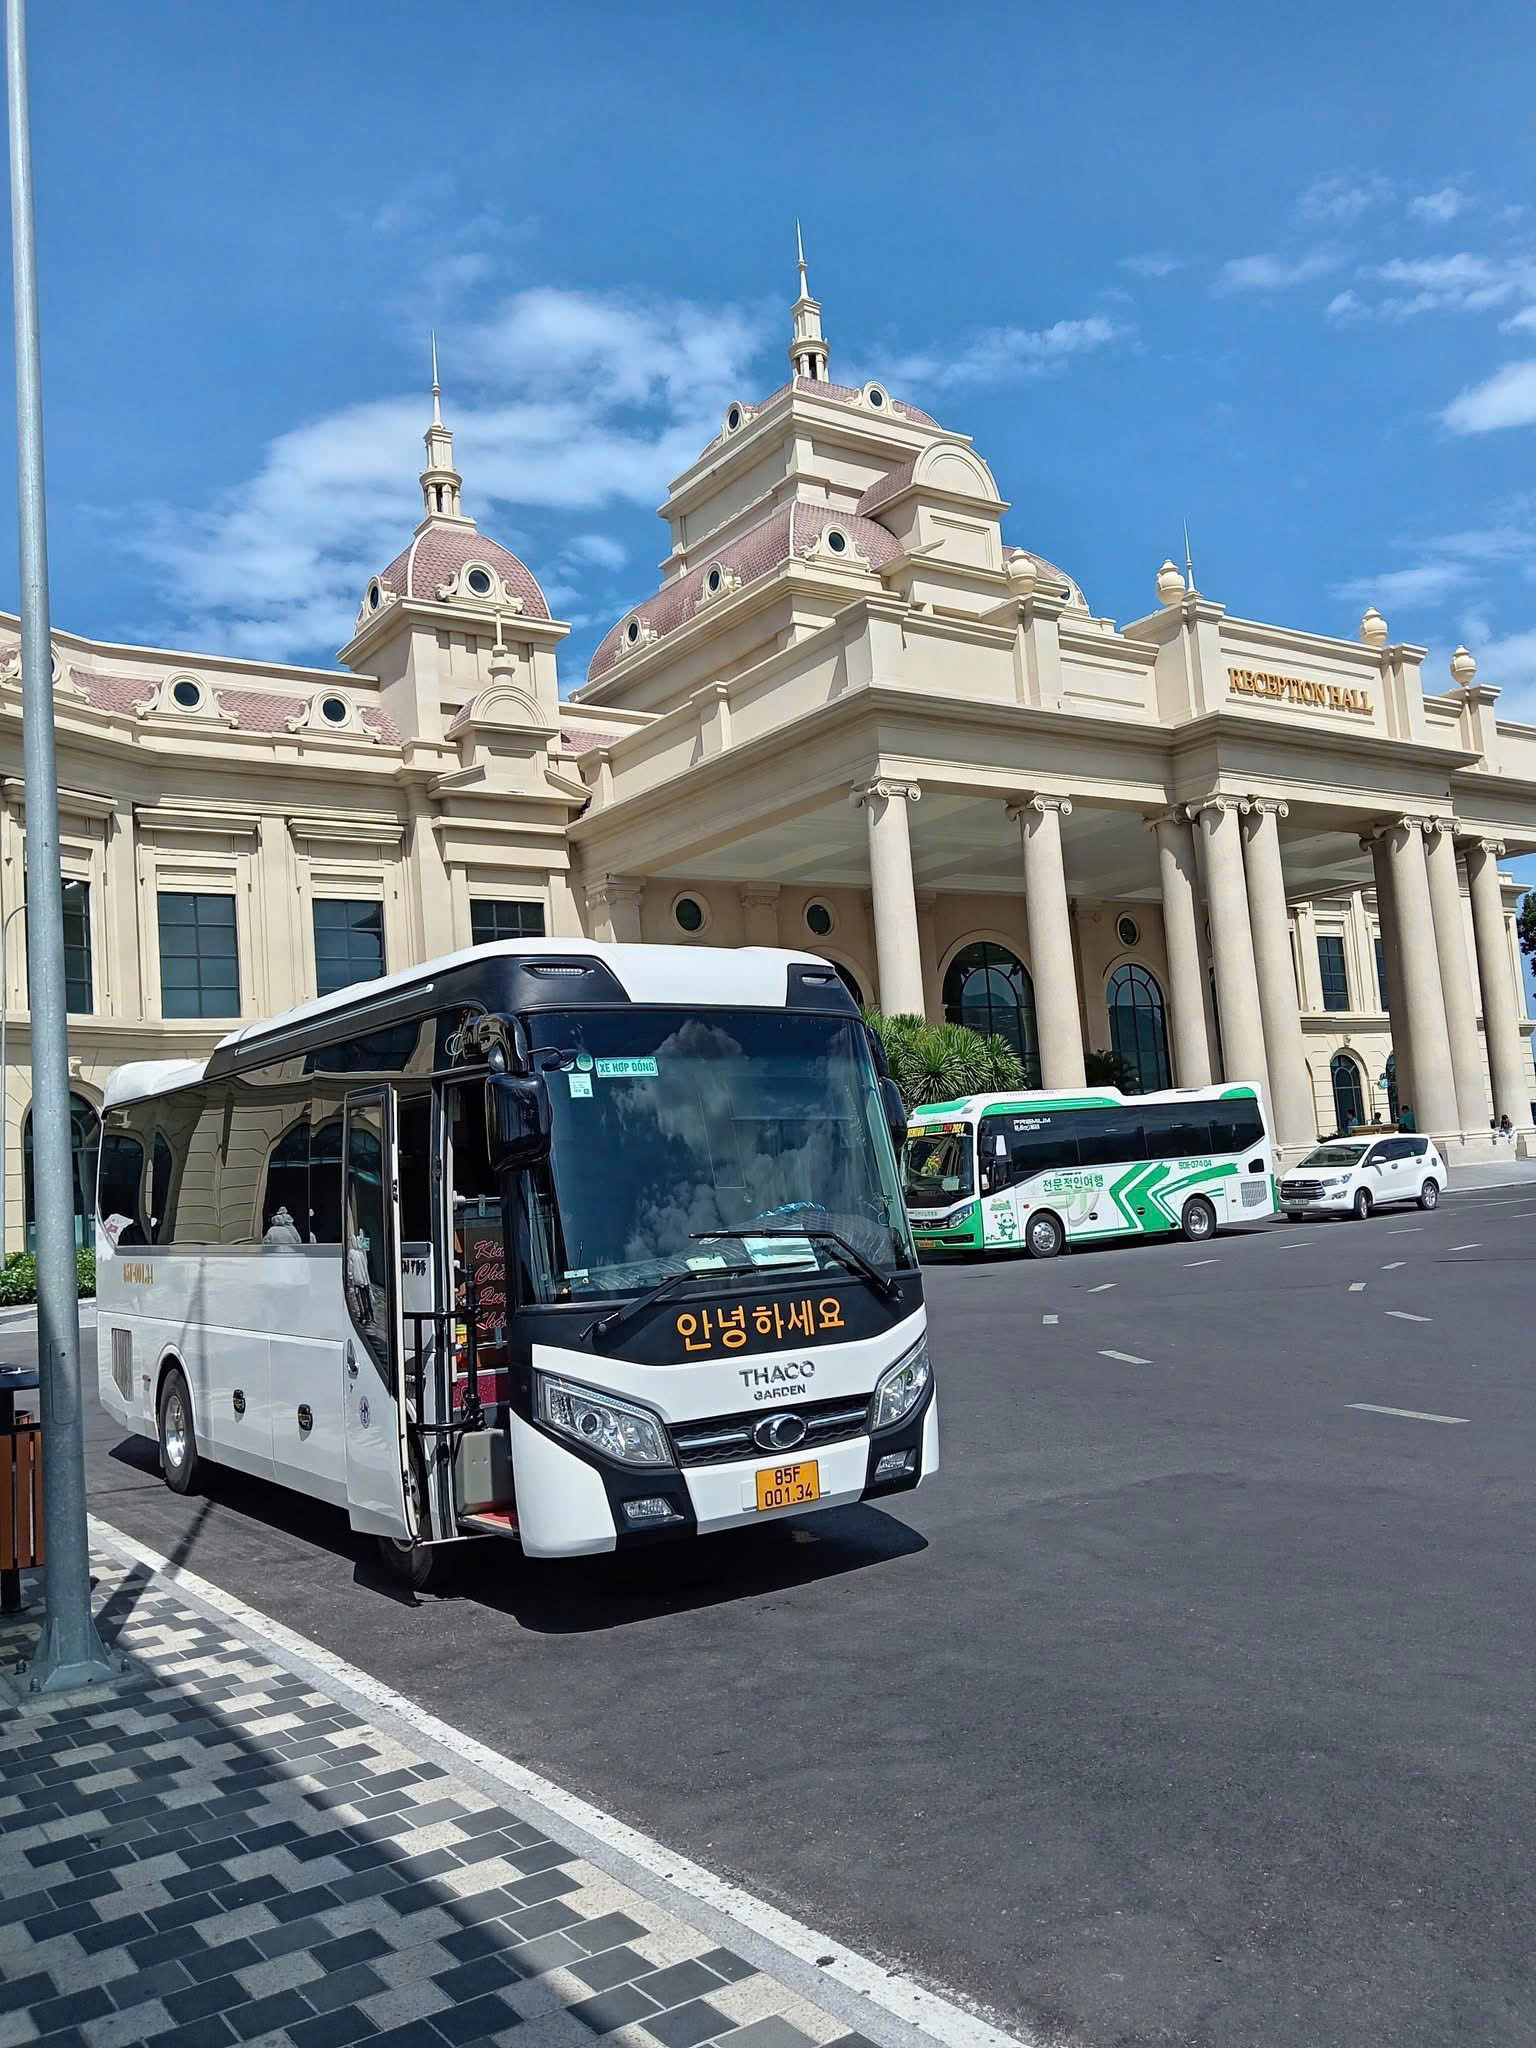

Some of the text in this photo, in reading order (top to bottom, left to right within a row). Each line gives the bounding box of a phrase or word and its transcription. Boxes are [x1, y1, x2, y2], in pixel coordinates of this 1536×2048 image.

[1227, 667, 1374, 713] RECEPTION HALL
[599, 1063, 611, 1073] XE
[1043, 1174, 1104, 1192] 전문적인여행
[676, 1297, 845, 1351] 안녕하세요
[739, 1360, 816, 1387] THACO
[754, 1384, 806, 1401] GARDEN
[775, 1466, 801, 1486] 85F
[765, 1482, 813, 1507] 001.34
